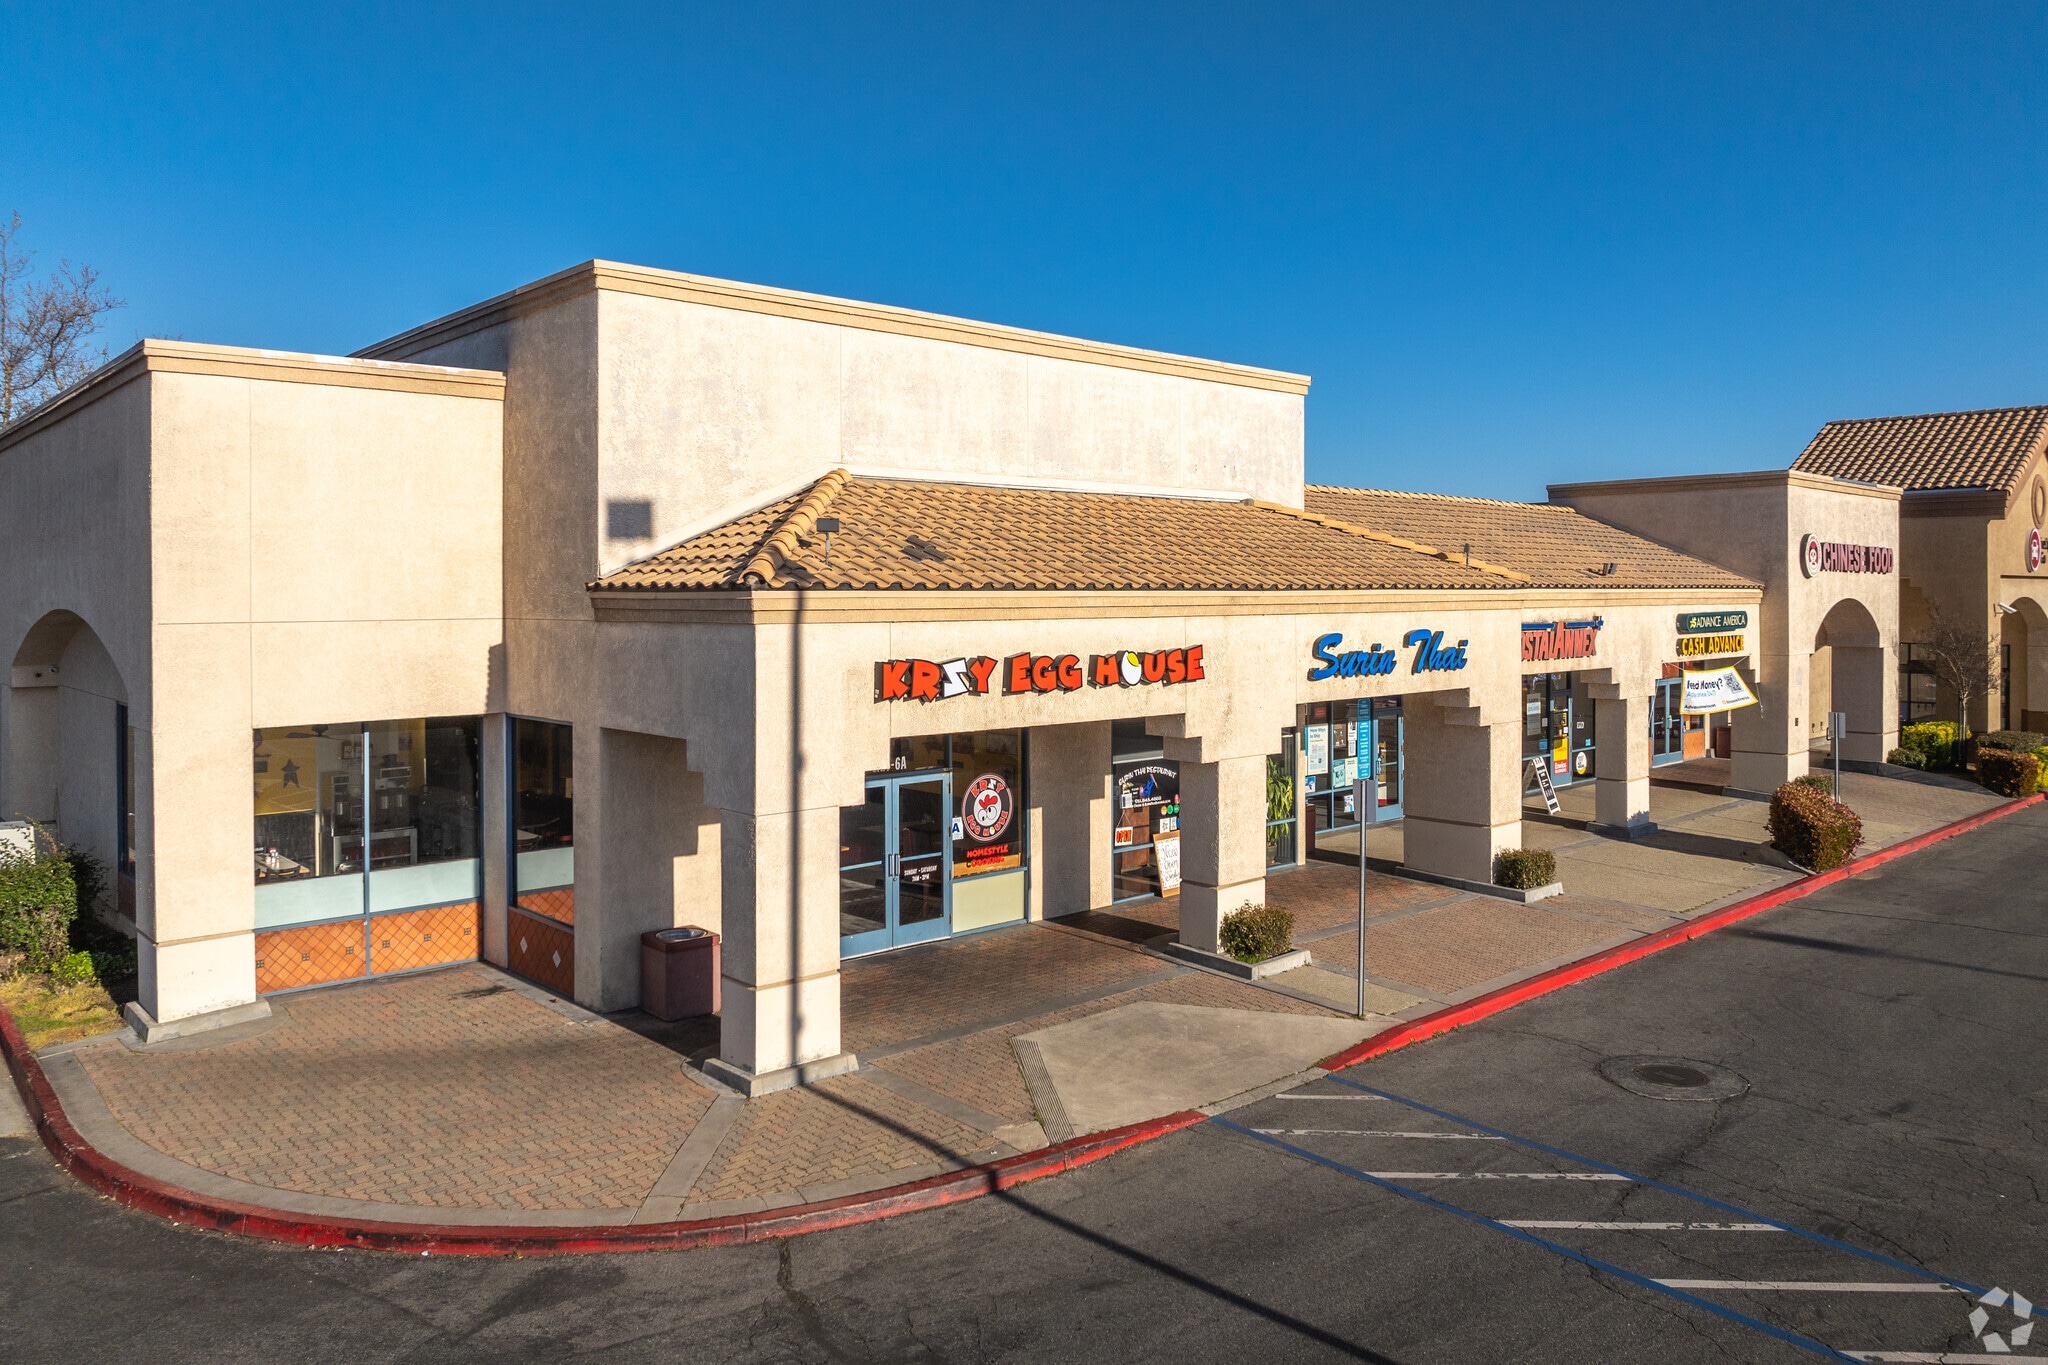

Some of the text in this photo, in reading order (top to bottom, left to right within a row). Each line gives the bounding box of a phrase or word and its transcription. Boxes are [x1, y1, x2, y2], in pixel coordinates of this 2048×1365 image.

[1822, 543, 1866, 572] CHINESE
[1869, 547, 1893, 574] FOOD
[1697, 615, 1746, 628] ADVANCE AMERICA
[1308, 629, 1469, 681] Surin Thai
[1681, 635, 1744, 655] CASH ADVANCE
[1004, 652, 1083, 696] EGG
[1089, 644, 1205, 688] HOUSE
[1116, 830, 1132, 843] OPEN
[966, 844, 1009, 858] HOMESTYLE
